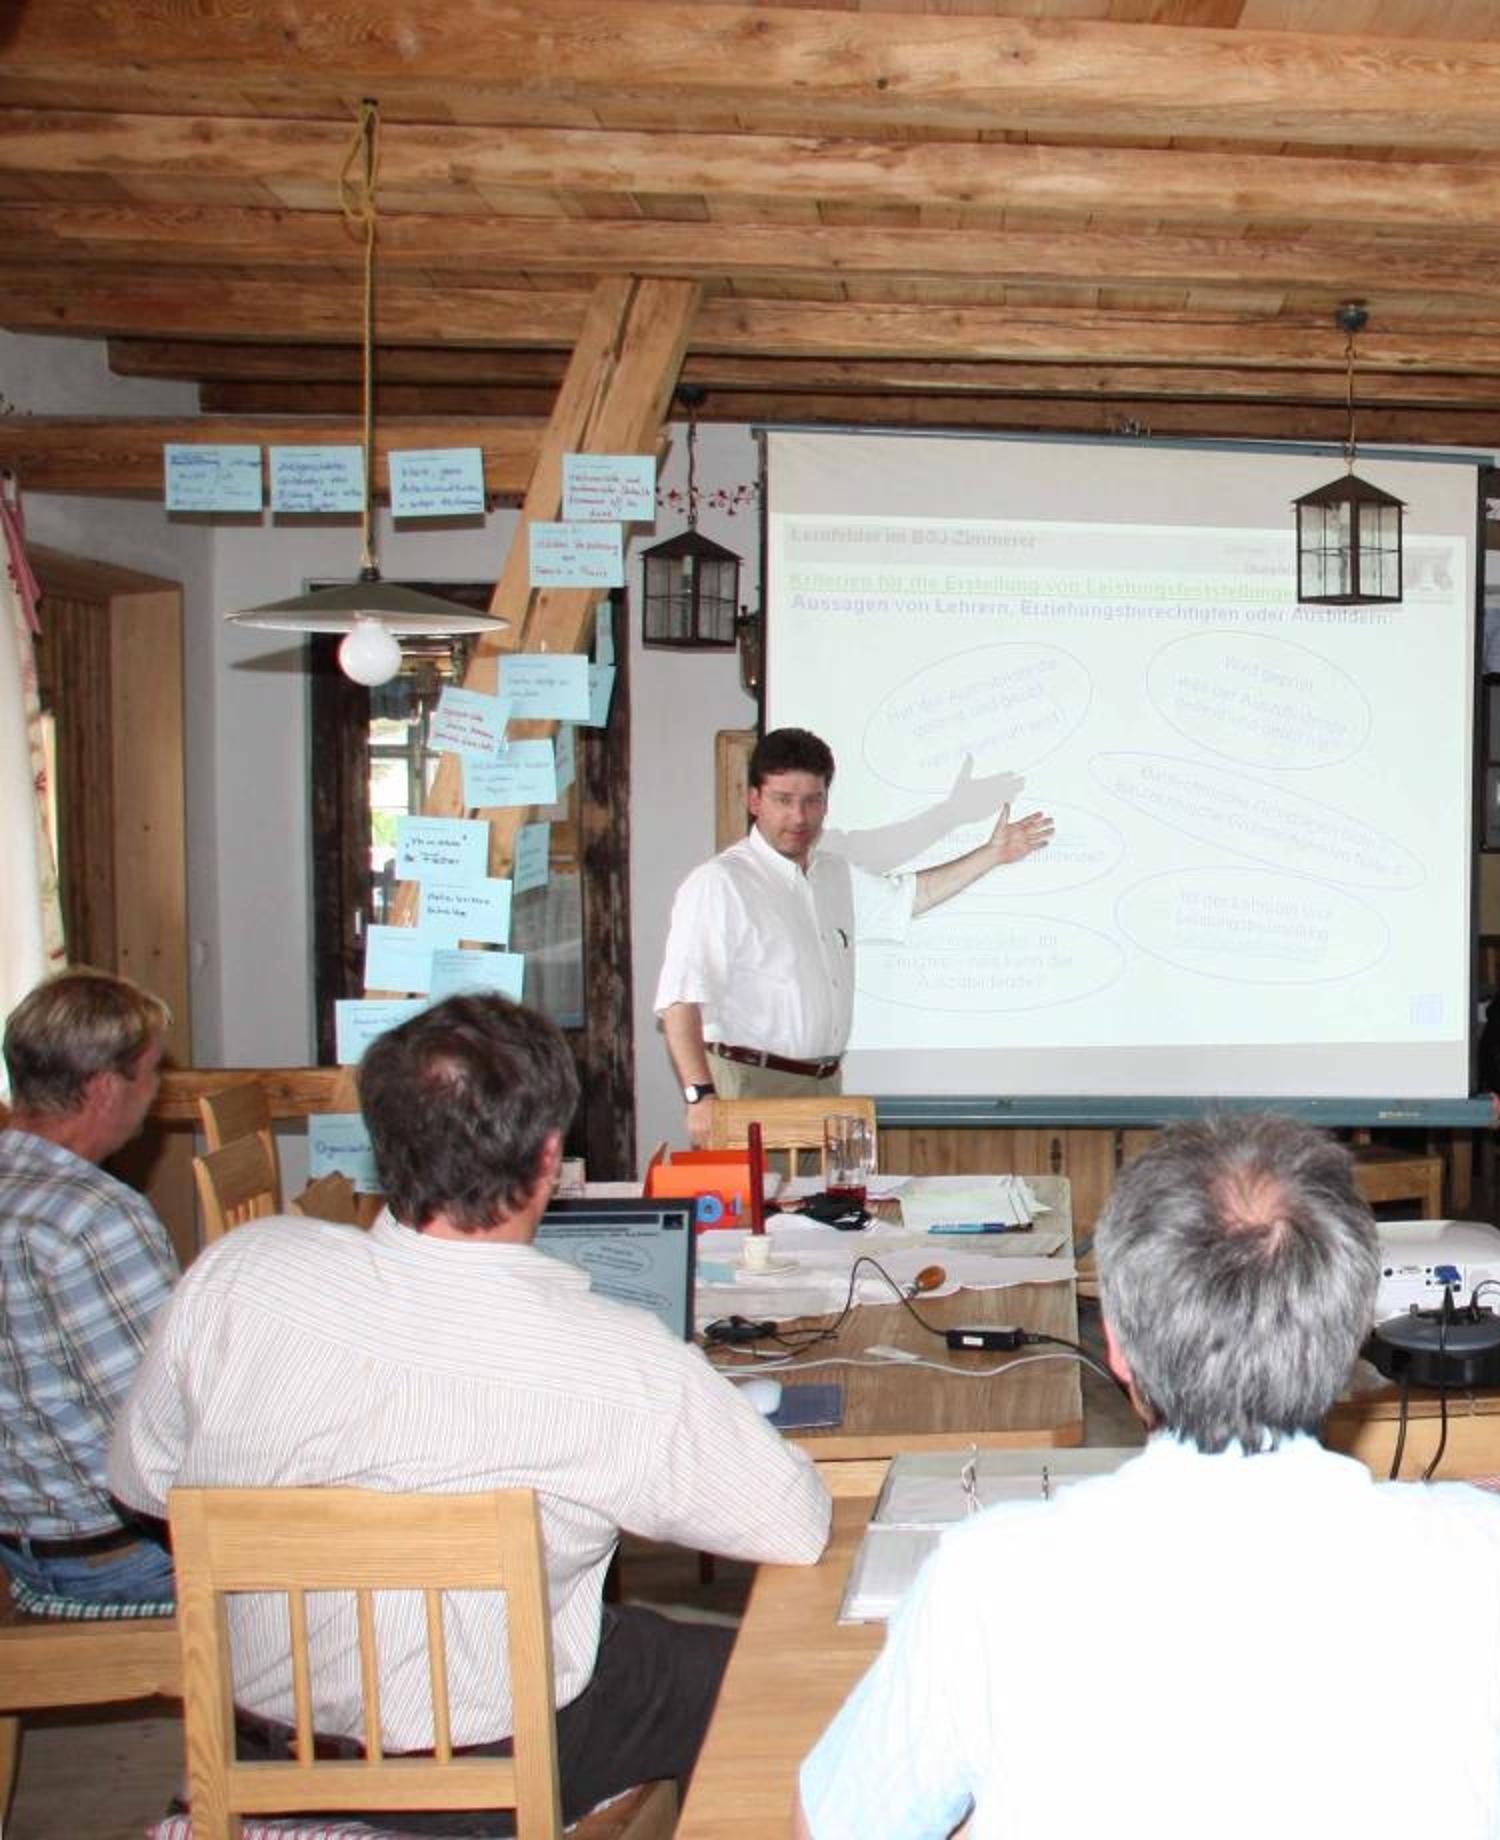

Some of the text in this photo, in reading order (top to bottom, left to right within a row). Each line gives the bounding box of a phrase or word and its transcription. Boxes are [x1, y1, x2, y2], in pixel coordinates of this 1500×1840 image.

[945, 575, 1039, 596] Erstellung
[791, 594, 889, 614] Aussagen
[895, 599, 929, 614] von
[1245, 607, 1284, 622] oder
